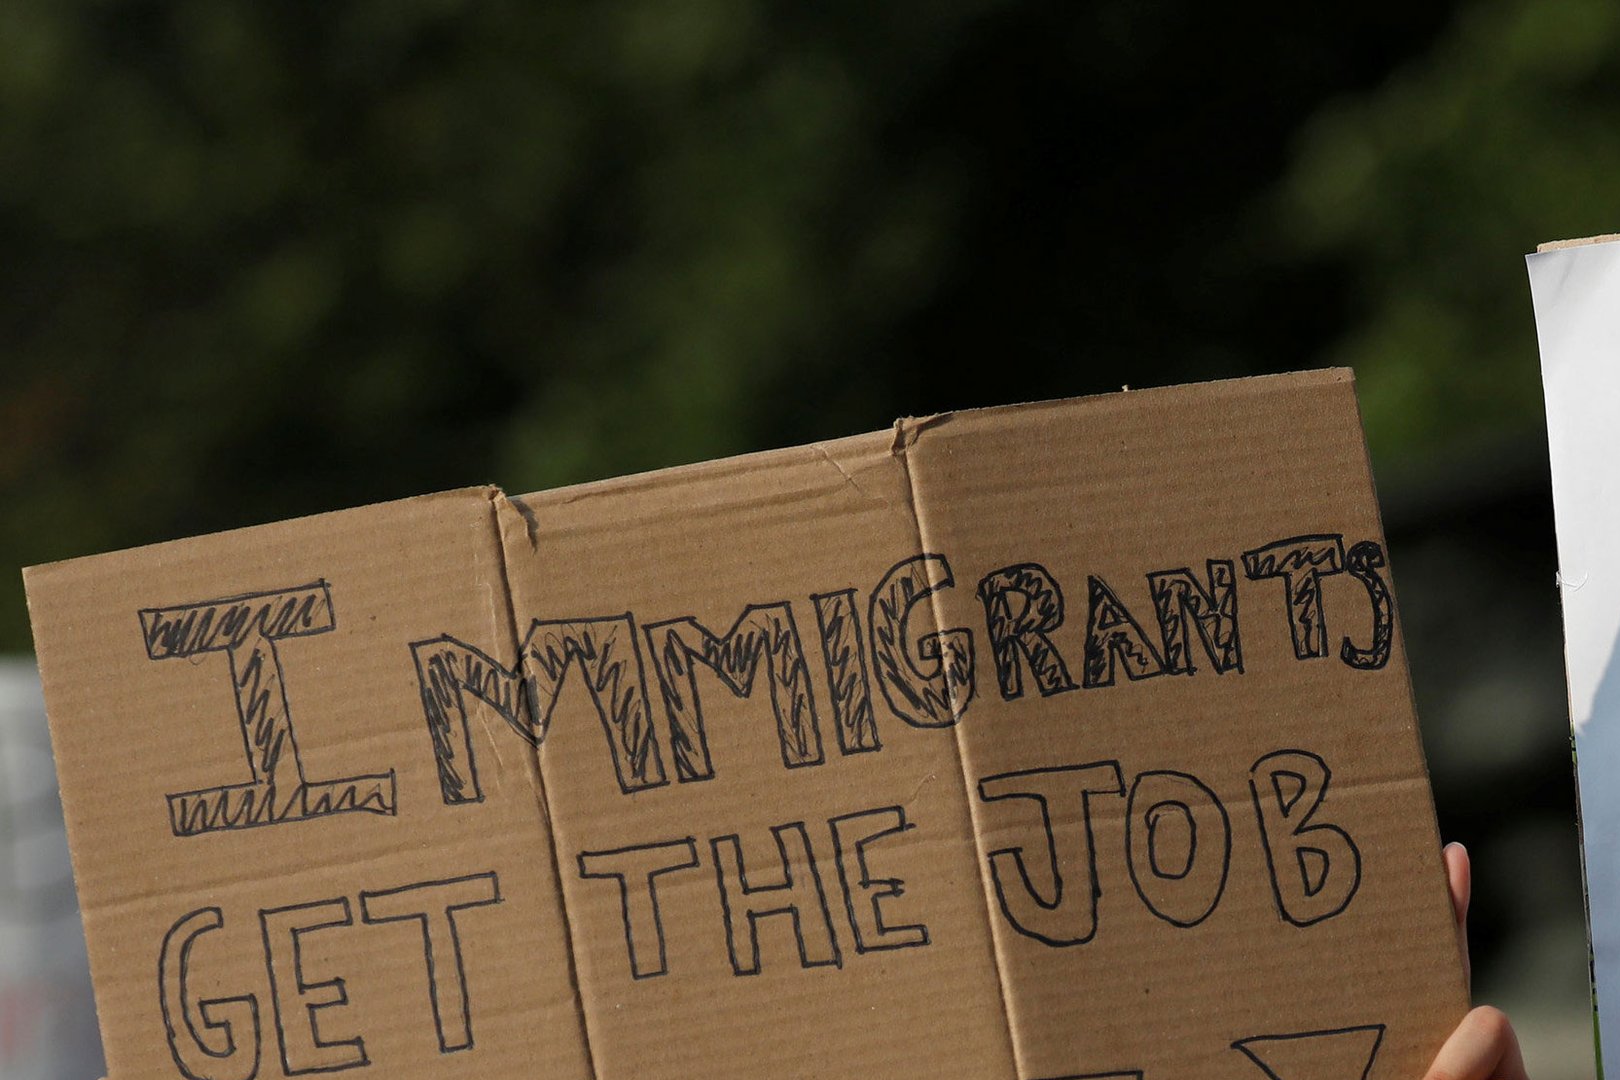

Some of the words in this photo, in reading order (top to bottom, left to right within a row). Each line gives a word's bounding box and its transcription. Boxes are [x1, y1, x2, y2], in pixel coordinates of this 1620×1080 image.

[138, 534, 1393, 837] IMMIGRANTS
[577, 806, 931, 979] THE
[977, 749, 1361, 947] JOB
